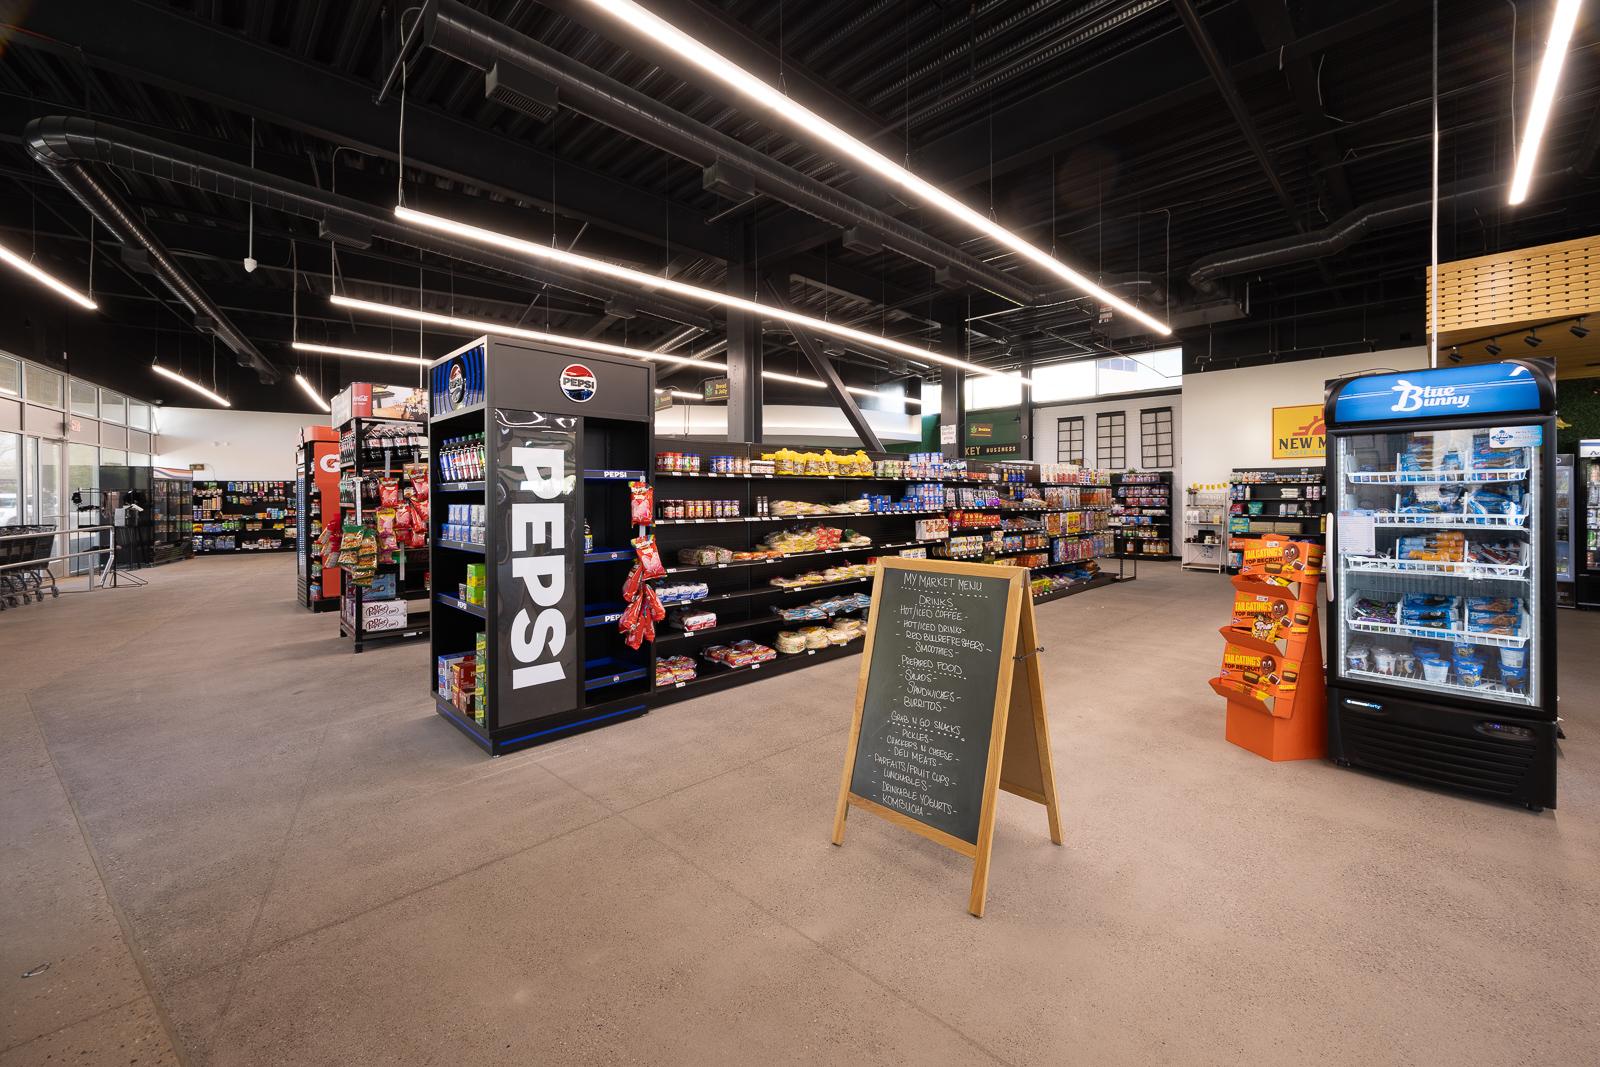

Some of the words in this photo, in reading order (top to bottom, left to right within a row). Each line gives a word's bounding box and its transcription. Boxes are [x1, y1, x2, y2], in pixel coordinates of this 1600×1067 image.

[563, 377, 594, 389] PEPSI
[964, 446, 981, 456] KEY
[1279, 437, 1312, 450] NEW
[1245, 547, 1283, 560] TAILGATING'S
[511, 446, 566, 690] PEPSI
[903, 572, 918, 586] MY
[919, 574, 955, 588] MARKET
[958, 578, 982, 591] MENU
[918, 595, 954, 607] DRINKS
[1235, 601, 1273, 612] TAILGATING'S
[900, 605, 933, 619] HOT/ICED
[934, 611, 962, 621] COFFEE
[903, 620, 936, 632] HOT/ICED
[938, 624, 962, 634] DRINKS
[905, 630, 922, 641] RED
[915, 641, 954, 658] SMOOTHIES
[901, 654, 934, 669] PREPARED
[936, 661, 963, 675] FOOD
[1224, 653, 1261, 667] TAILGATING'S
[905, 669, 932, 682] SALADS
[1236, 664, 1260, 672] RECRUIT
[907, 681, 955, 702] SANDWICHES
[890, 710, 909, 724] GRAB
[919, 718, 931, 728] GO
[933, 720, 961, 735] SNACKS
[902, 729, 929, 743] PICKLES
[886, 735, 918, 750] CRACKERS
[928, 748, 954, 761] CHEESE
[894, 746, 909, 758] DELI
[911, 752, 937, 766] MEATS
[883, 769, 928, 791] LUNCHABLES
[931, 772, 950, 787] CUPS
[882, 781, 918, 801] DRINKABLE
[920, 794, 952, 815] YOGURTS
[882, 793, 924, 816] KOMBUCHA
